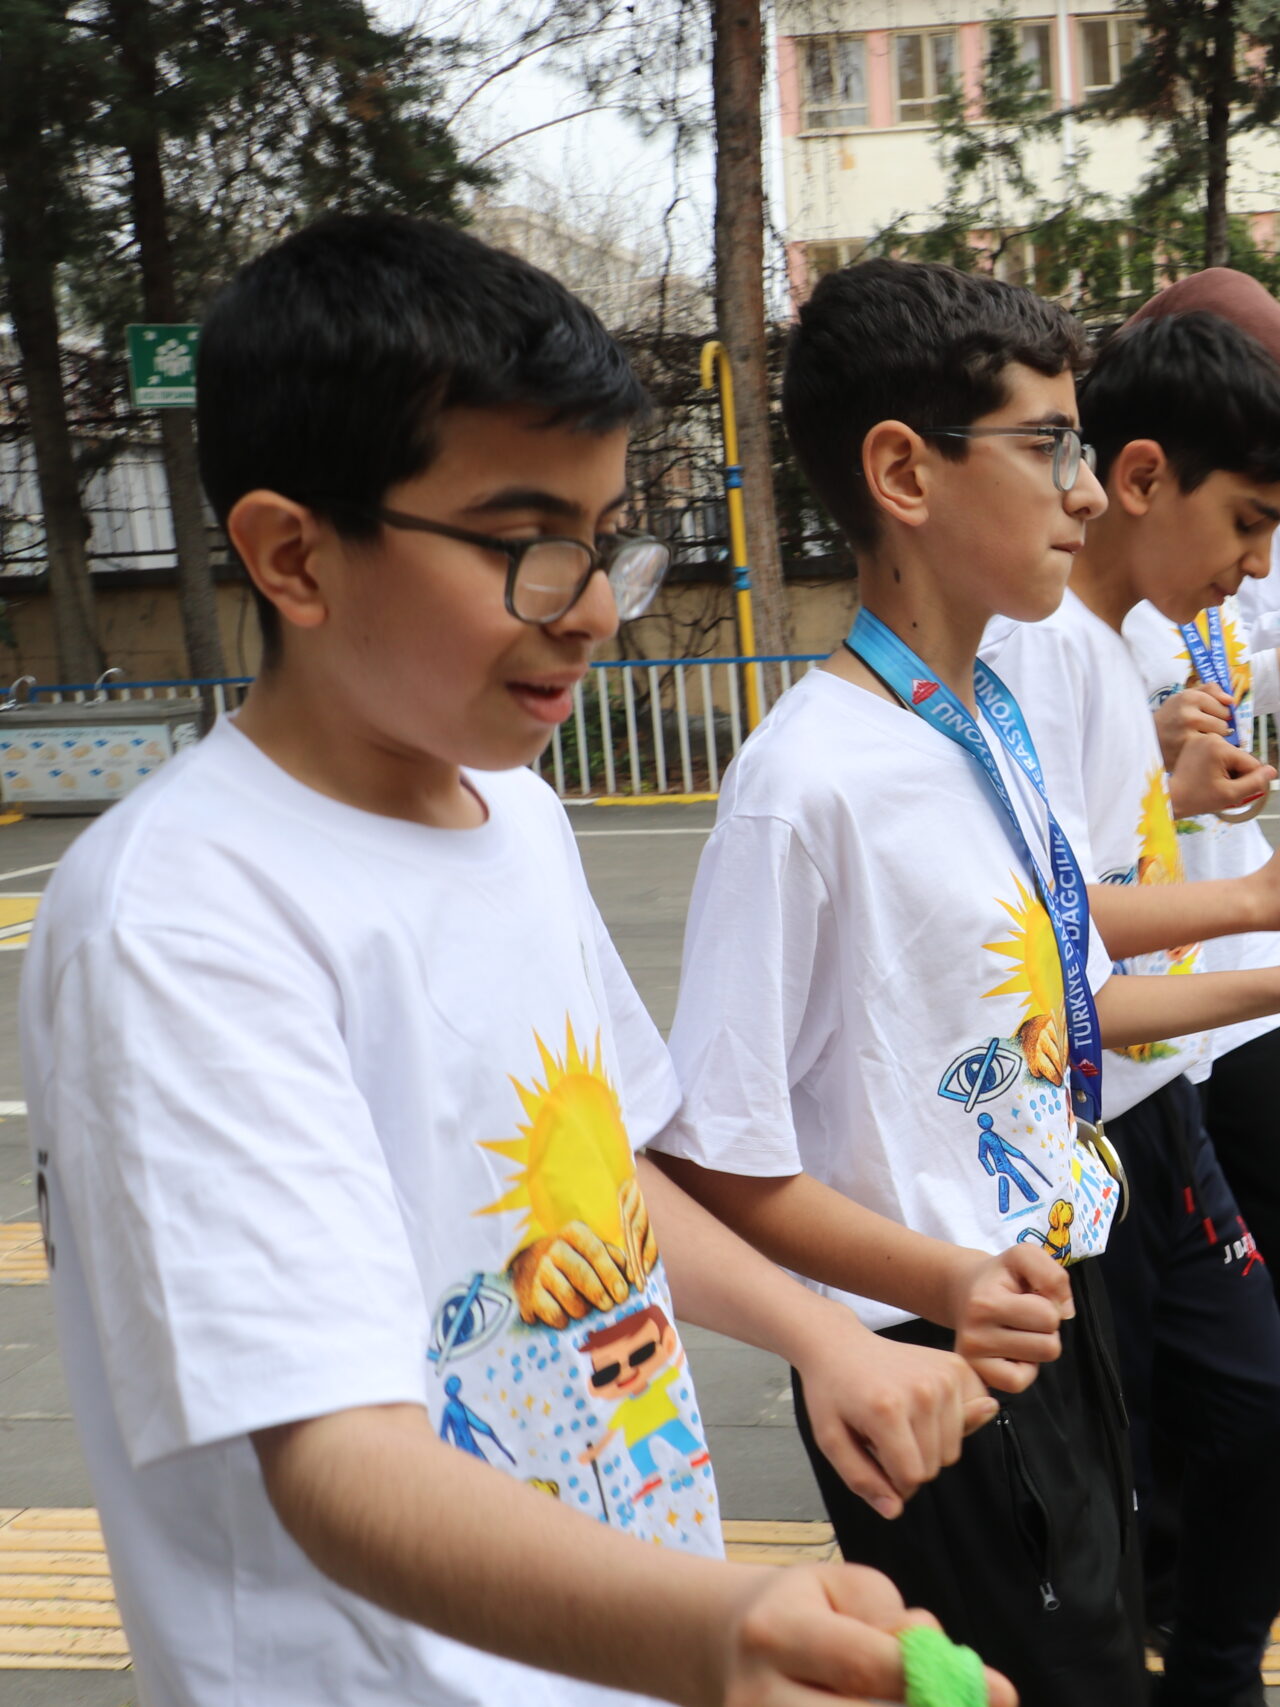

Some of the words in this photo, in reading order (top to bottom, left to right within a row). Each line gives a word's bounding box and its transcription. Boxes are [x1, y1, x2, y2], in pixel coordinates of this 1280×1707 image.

[1192, 646, 1220, 684] RKİYE
[1053, 830, 1081, 941] DAĞCILIK
[1066, 962, 1093, 1049] TÜRKİYE
